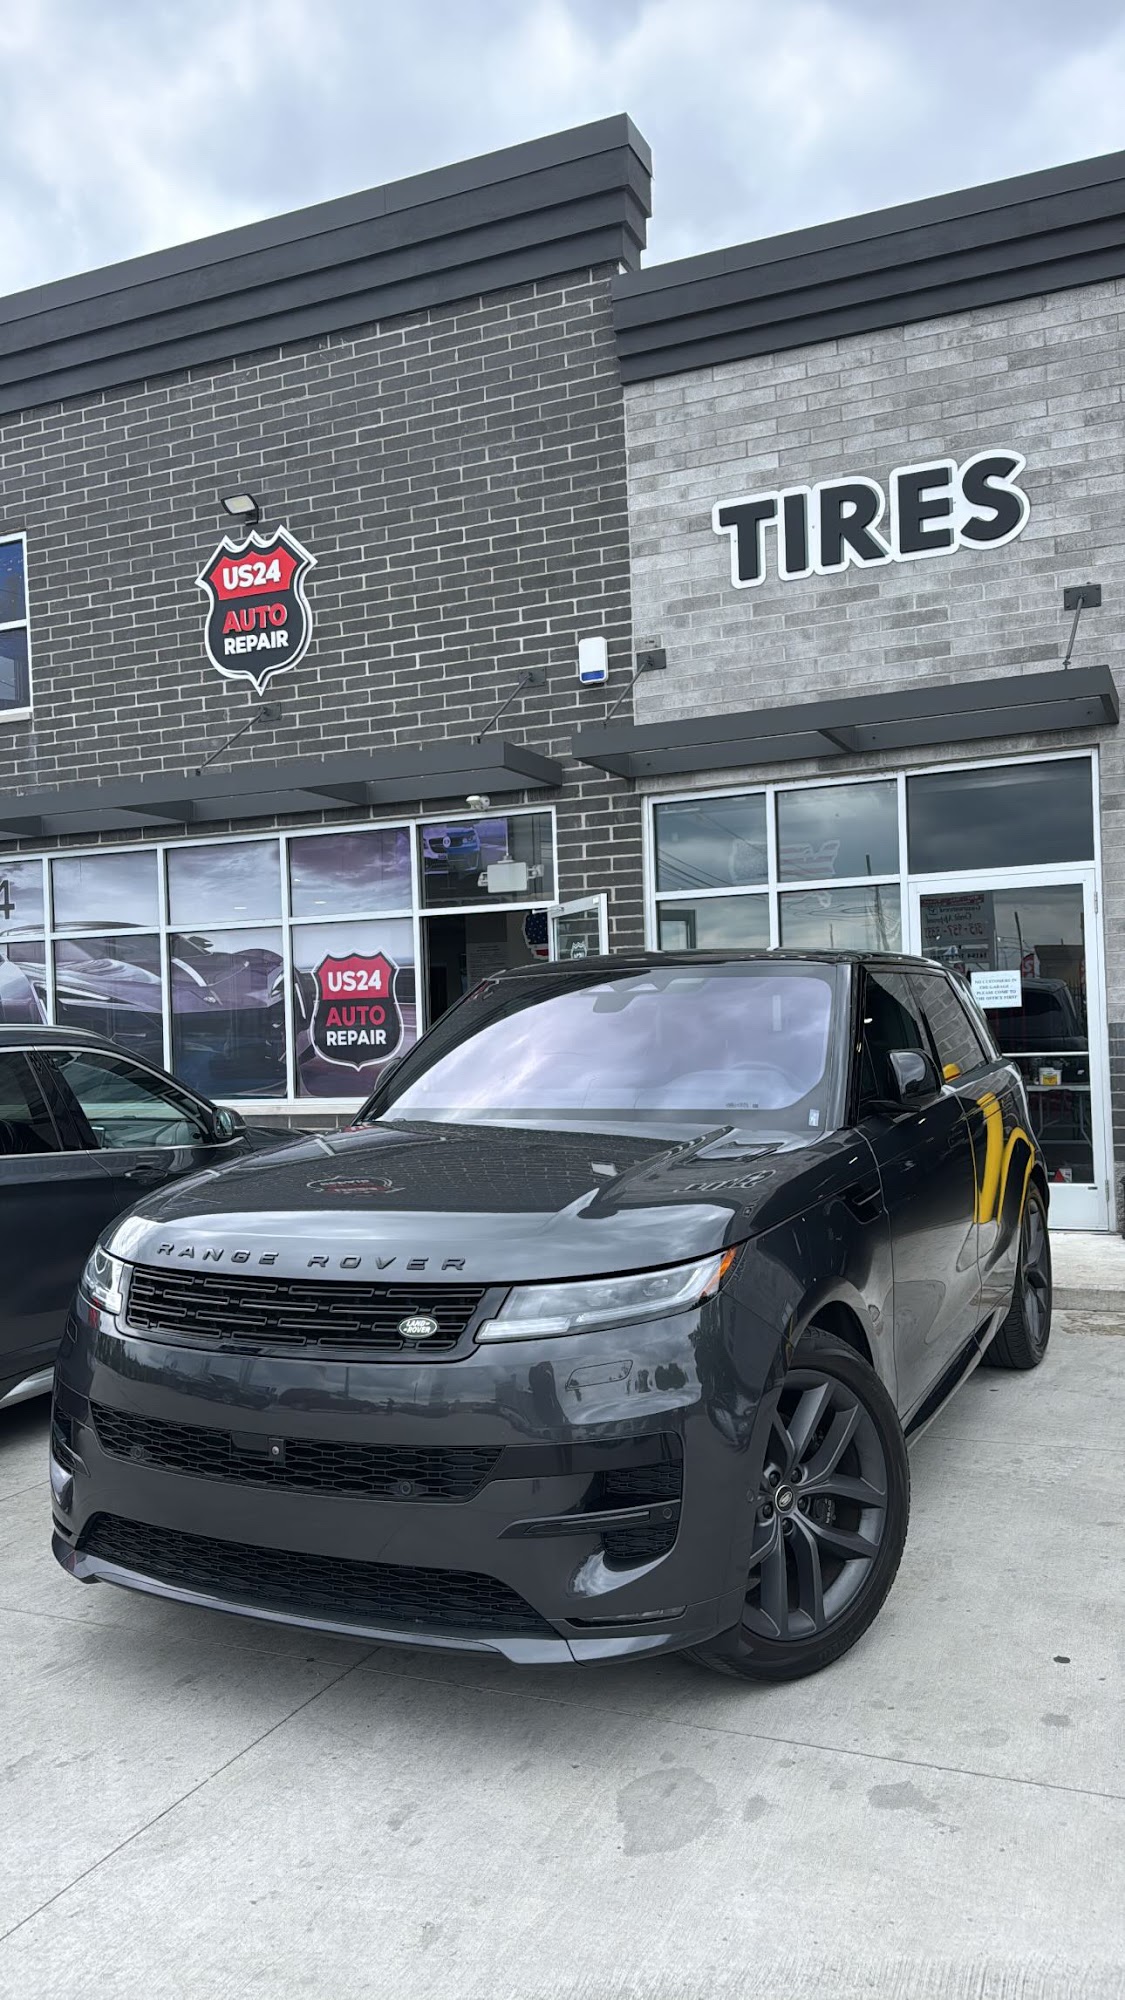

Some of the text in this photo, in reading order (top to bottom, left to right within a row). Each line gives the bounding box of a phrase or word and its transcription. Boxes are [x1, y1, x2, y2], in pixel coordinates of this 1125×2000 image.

[718, 455, 1024, 583] TIRES
[222, 558, 281, 591] US24
[222, 602, 287, 634] AUTO
[224, 630, 289, 655] REPAIR
[327, 969, 382, 992] US24
[326, 1005, 386, 1027] AUTO
[326, 1028, 387, 1046] REPAIR
[156, 1242, 467, 1271] RANGE ROVER
